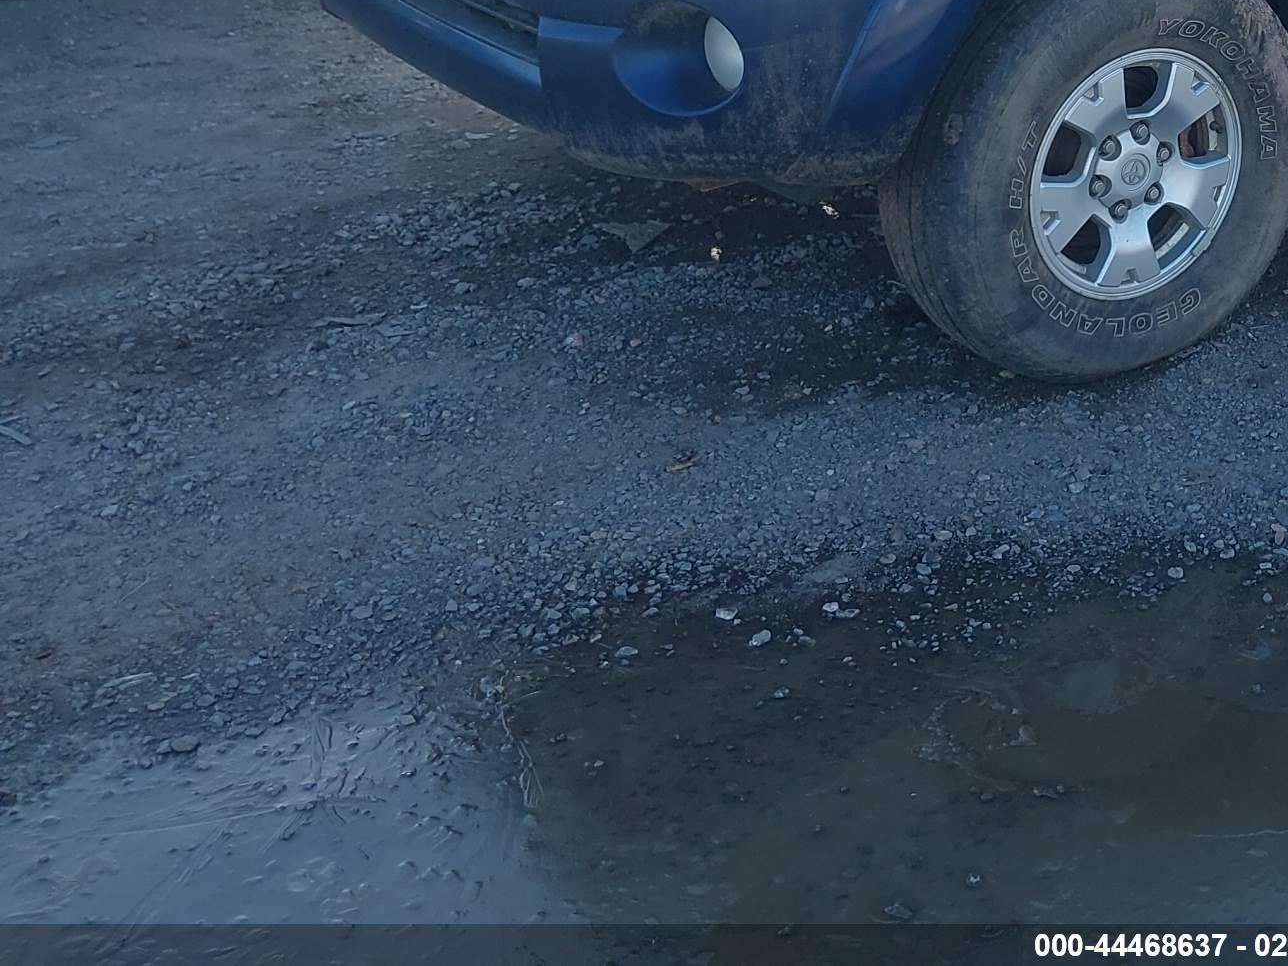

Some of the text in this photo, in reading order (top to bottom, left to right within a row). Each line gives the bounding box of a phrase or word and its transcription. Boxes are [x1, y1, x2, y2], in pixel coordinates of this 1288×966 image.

[1157, 17, 1279, 161] YOKOHAMA
[1008, 120, 1202, 337] GEOLANDAR H/T
